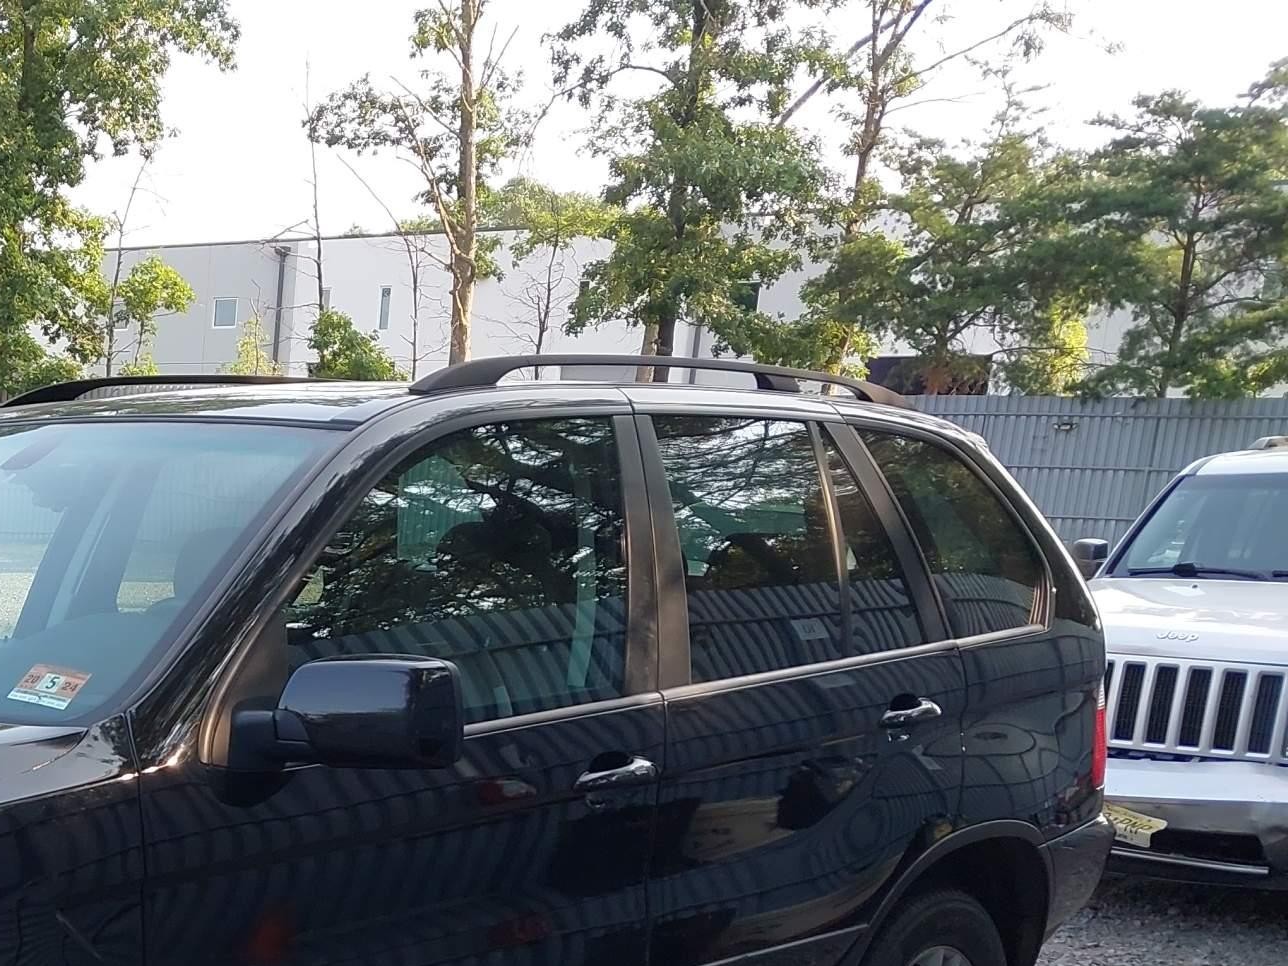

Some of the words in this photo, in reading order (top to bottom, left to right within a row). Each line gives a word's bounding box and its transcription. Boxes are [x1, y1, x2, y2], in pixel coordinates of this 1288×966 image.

[1155, 631, 1200, 643] Jeep
[24, 673, 41, 685] 20
[45, 675, 61, 690] 5
